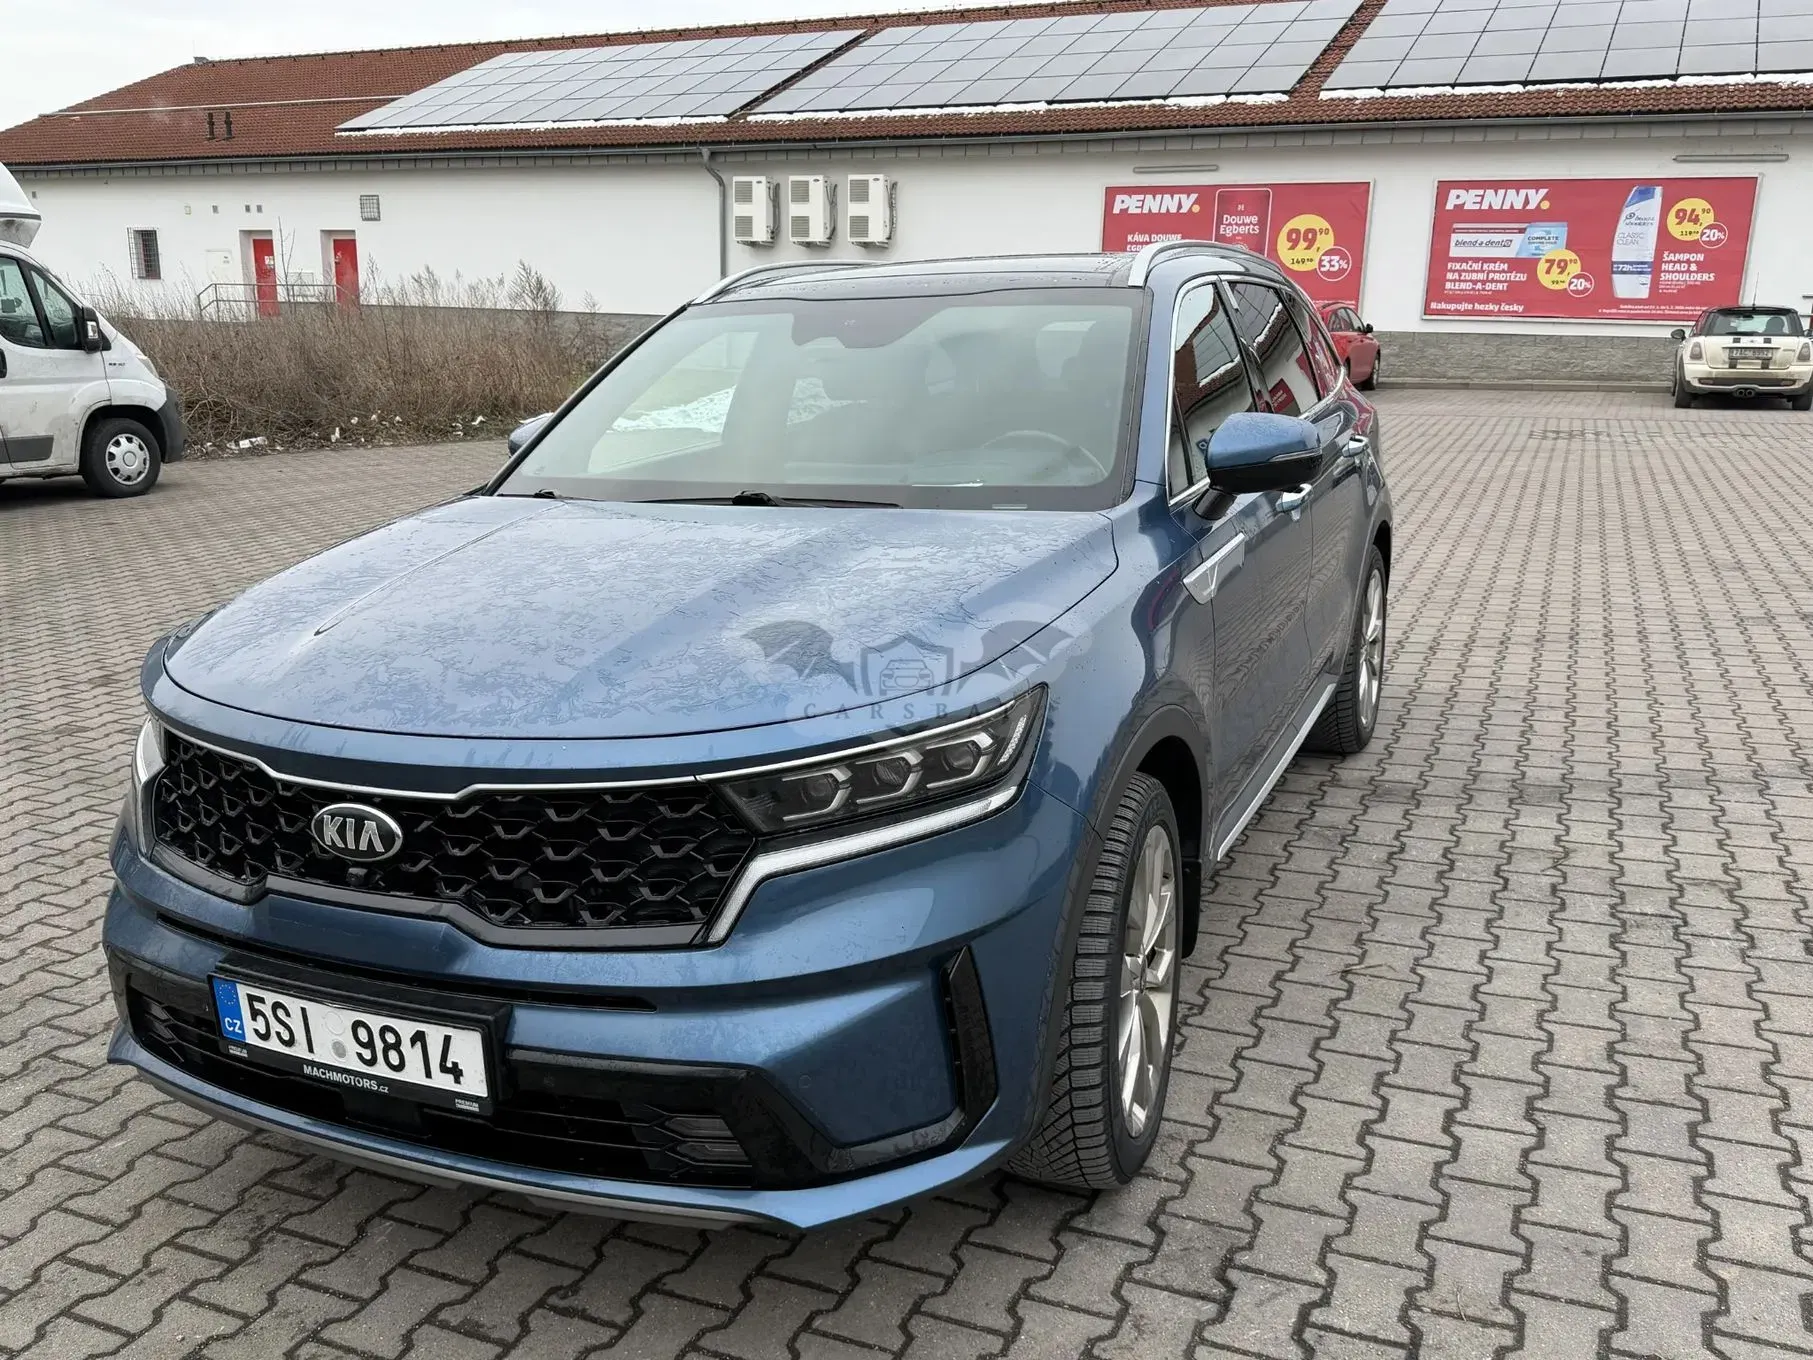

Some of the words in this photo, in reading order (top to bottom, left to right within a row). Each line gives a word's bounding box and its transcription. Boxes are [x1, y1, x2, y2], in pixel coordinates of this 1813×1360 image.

[1223, 214, 1258, 224] Douwe
[1220, 225, 1259, 237] Egberts
[1701, 229, 1725, 241] 20%
[1127, 232, 1150, 242] KÁVA
[1151, 234, 1182, 242] DOUWE
[1663, 251, 1704, 261] ŠAMPON
[1320, 255, 1348, 272] 33%
[1447, 261, 1482, 270] FIXAČNÍ
[1483, 262, 1508, 271] KRÉM
[1661, 263, 1688, 271] HEAD
[1689, 263, 1697, 271] &
[1446, 272, 1460, 280] NA
[1460, 270, 1488, 281] ZUBNÍ
[1488, 271, 1527, 281] PROTÉZU
[1660, 273, 1715, 281] SHOULDERS
[1445, 282, 1508, 291] BLEND-A-DENT
[1570, 278, 1591, 291] 20%
[1430, 302, 1473, 312] Nakupujte
[1474, 302, 1499, 312] hezky
[1500, 302, 1524, 312] česky
[323, 814, 385, 852] KIA
[224, 1017, 242, 1034] CZ
[246, 992, 315, 1054] 5SI
[351, 1019, 464, 1085] 9814
[303, 1064, 389, 1093] MACHMOTORS.cz
